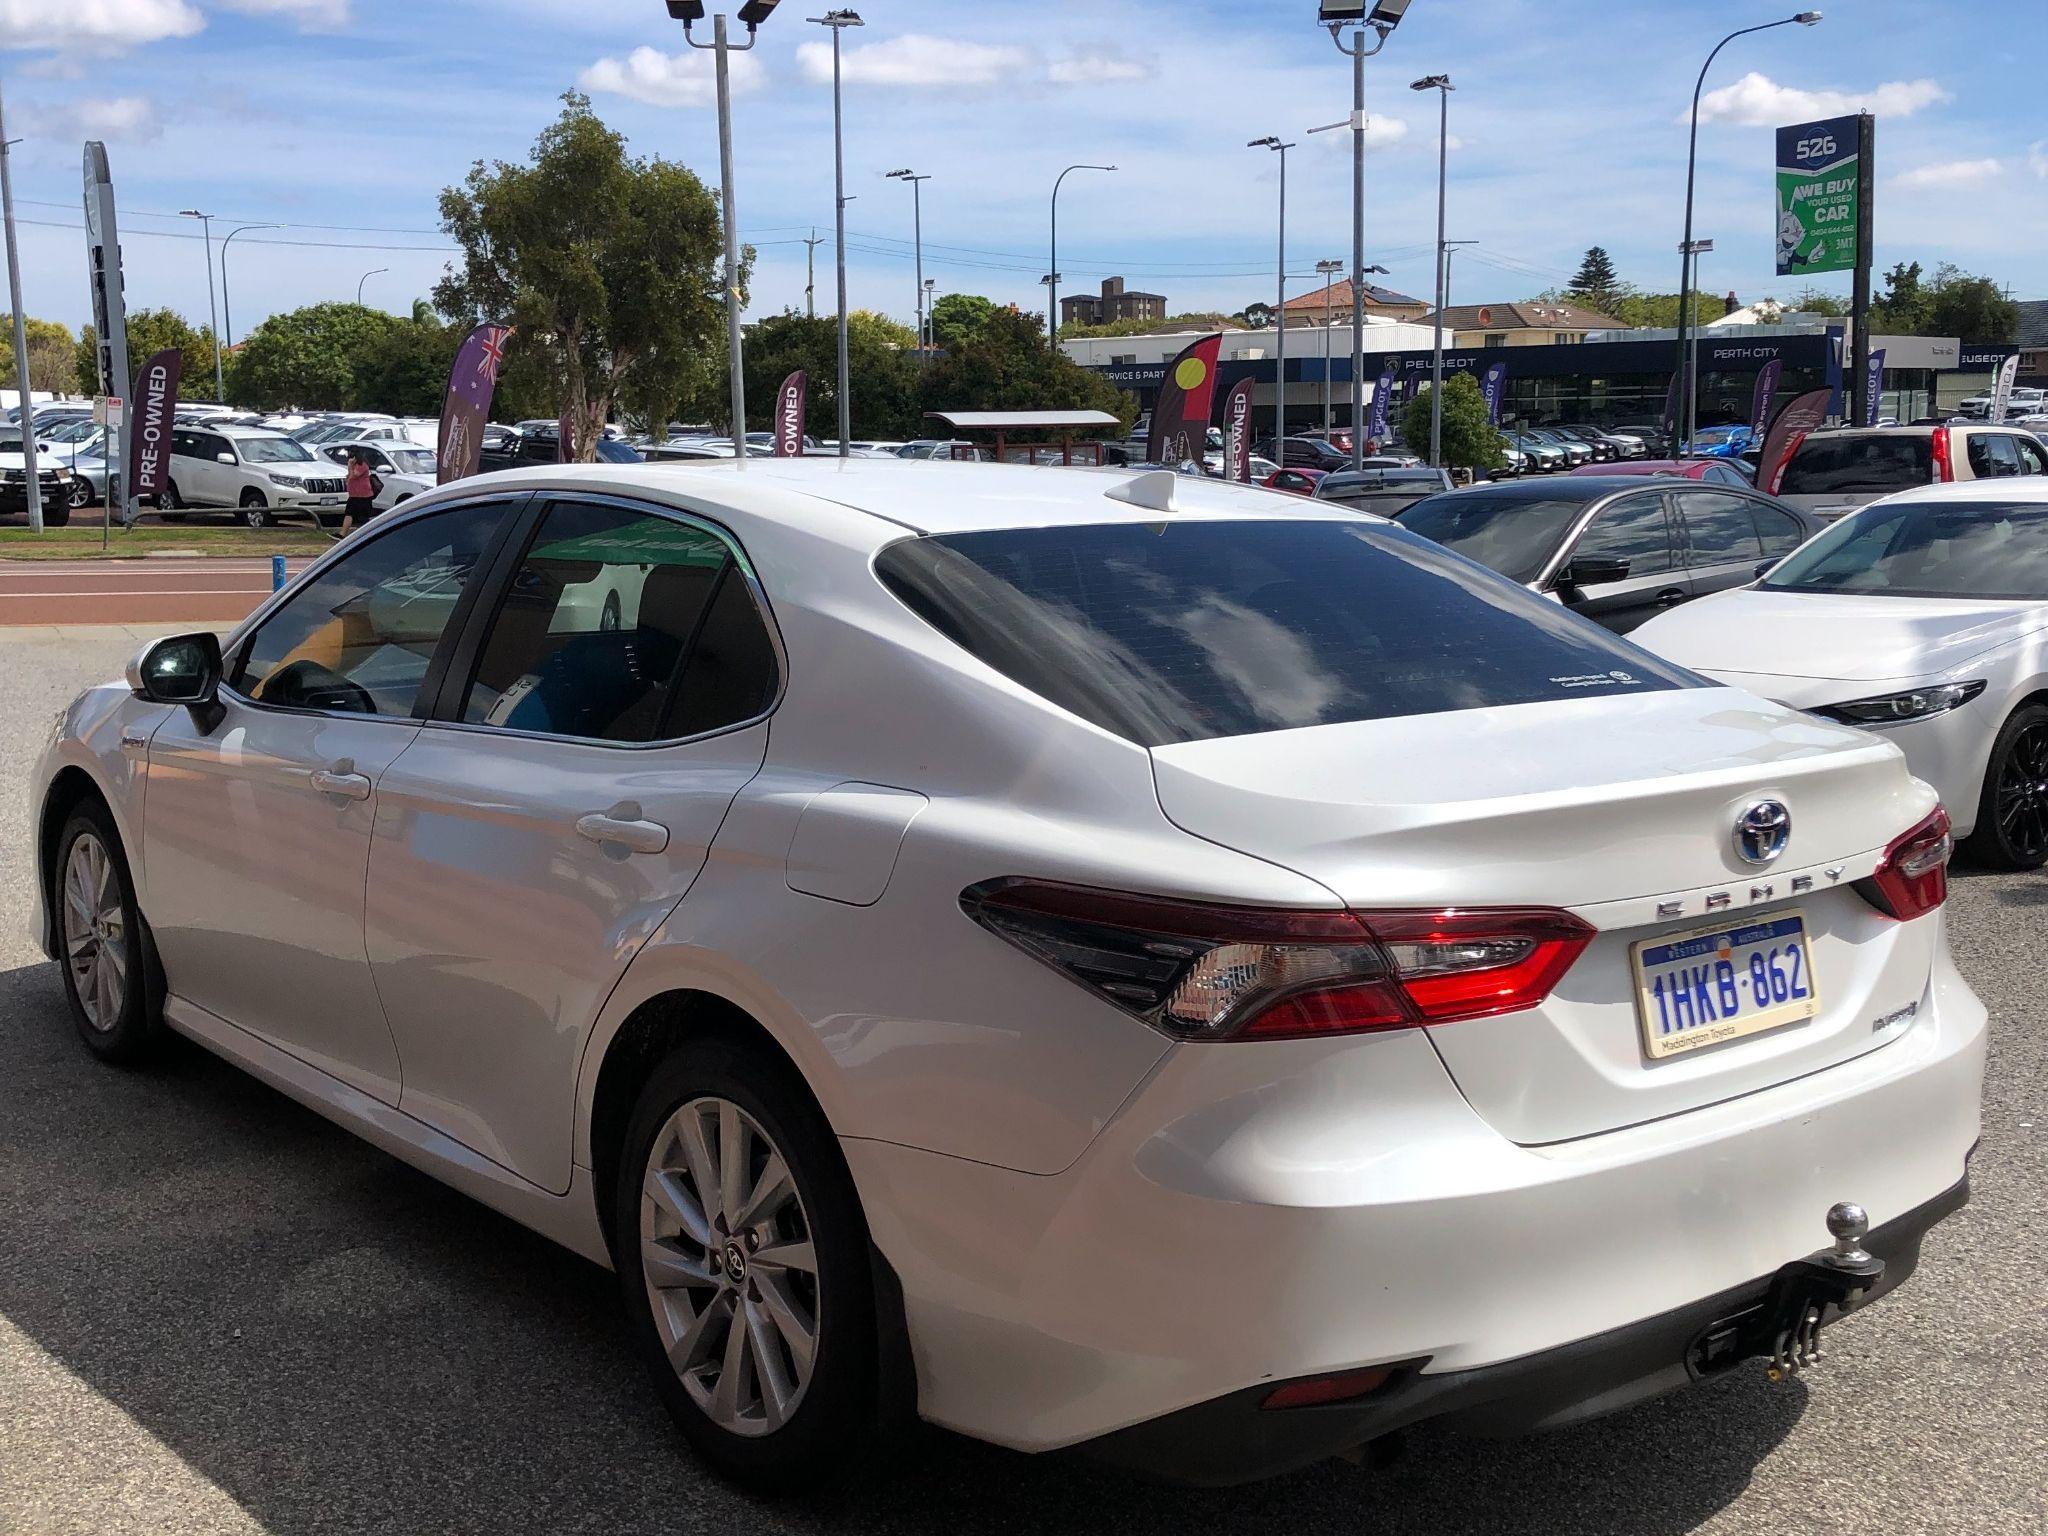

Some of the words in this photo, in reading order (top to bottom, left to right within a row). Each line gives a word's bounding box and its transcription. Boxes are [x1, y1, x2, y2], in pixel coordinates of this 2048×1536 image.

[1796, 135, 1837, 160] 526
[1826, 177, 1857, 194] BUY
[1807, 197, 1829, 207] YOUR
[1830, 194, 1853, 204] USED
[1814, 204, 1850, 223] CAR
[1713, 347, 1751, 359] PERTH
[1753, 347, 1779, 358] CITY
[1374, 389, 1387, 434] PEUGEOT
[139, 365, 167, 488] PRE-OWNED
[1232, 392, 1247, 483] RE-OWNED
[1656, 865, 1846, 917] CAMRY
[1661, 1032, 1710, 1052] Maddington
[1710, 1025, 1736, 1043] Toyota
